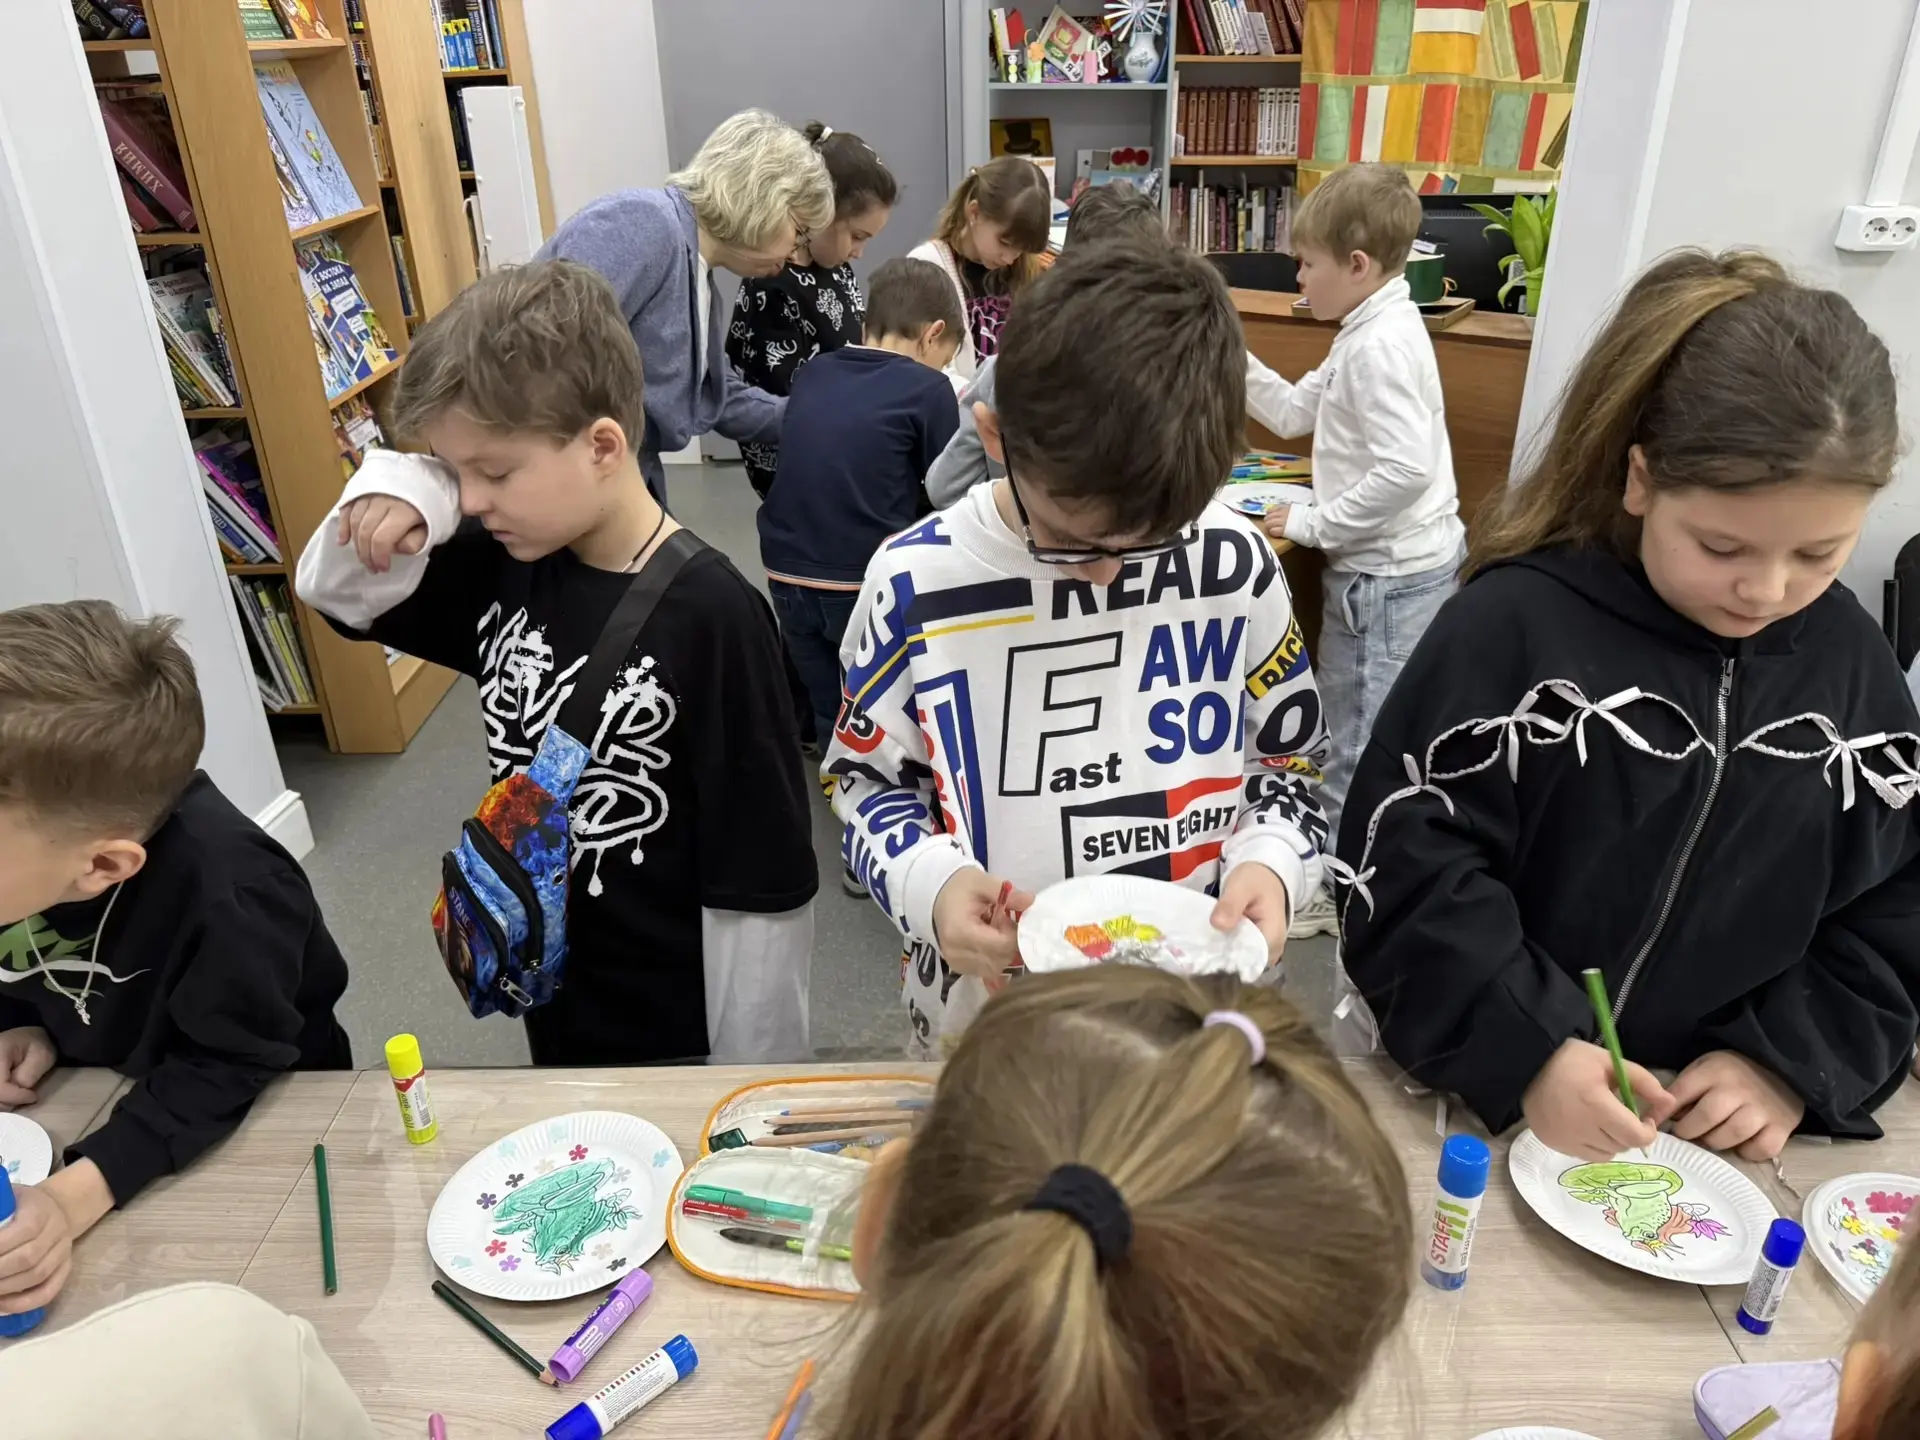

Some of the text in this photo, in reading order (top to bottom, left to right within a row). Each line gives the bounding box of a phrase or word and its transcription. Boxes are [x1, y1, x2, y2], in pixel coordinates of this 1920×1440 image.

[114, 142, 163, 193] ХИМИЯ
[1083, 824, 1170, 862] SEVEN
[1430, 1213, 1453, 1265] STAFF
